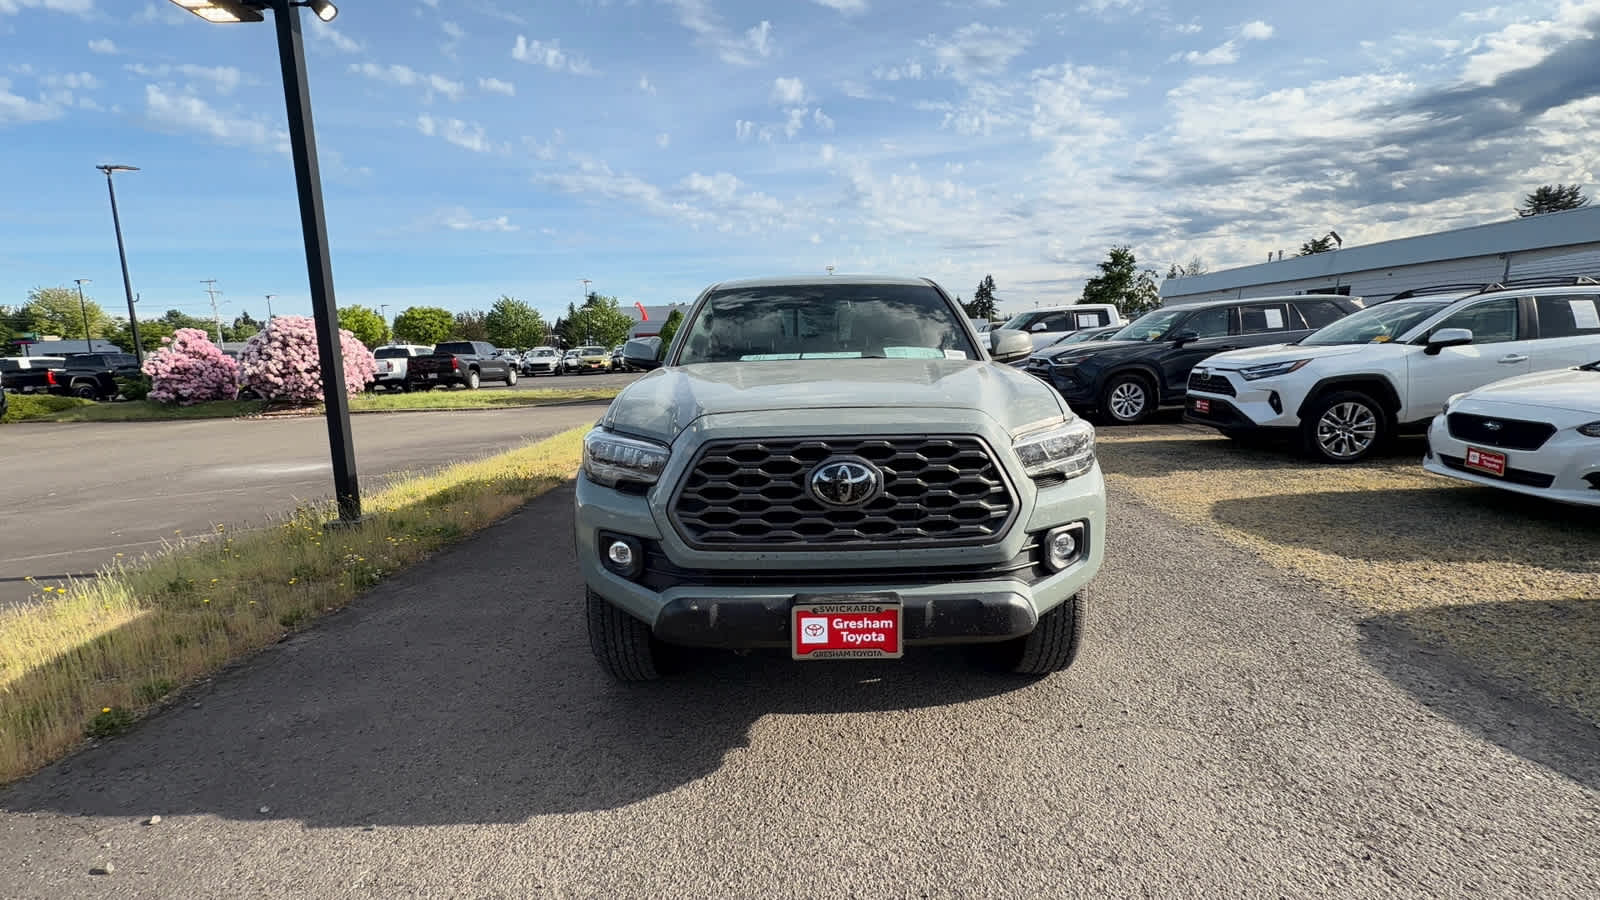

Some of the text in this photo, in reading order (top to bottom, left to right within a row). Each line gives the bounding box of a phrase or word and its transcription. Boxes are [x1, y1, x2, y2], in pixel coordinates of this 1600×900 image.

[819, 605, 875, 613] SWICKARD
[832, 617, 893, 629] Gresham
[840, 631, 885, 644] Toyota
[812, 650, 851, 658] GRESHAM
